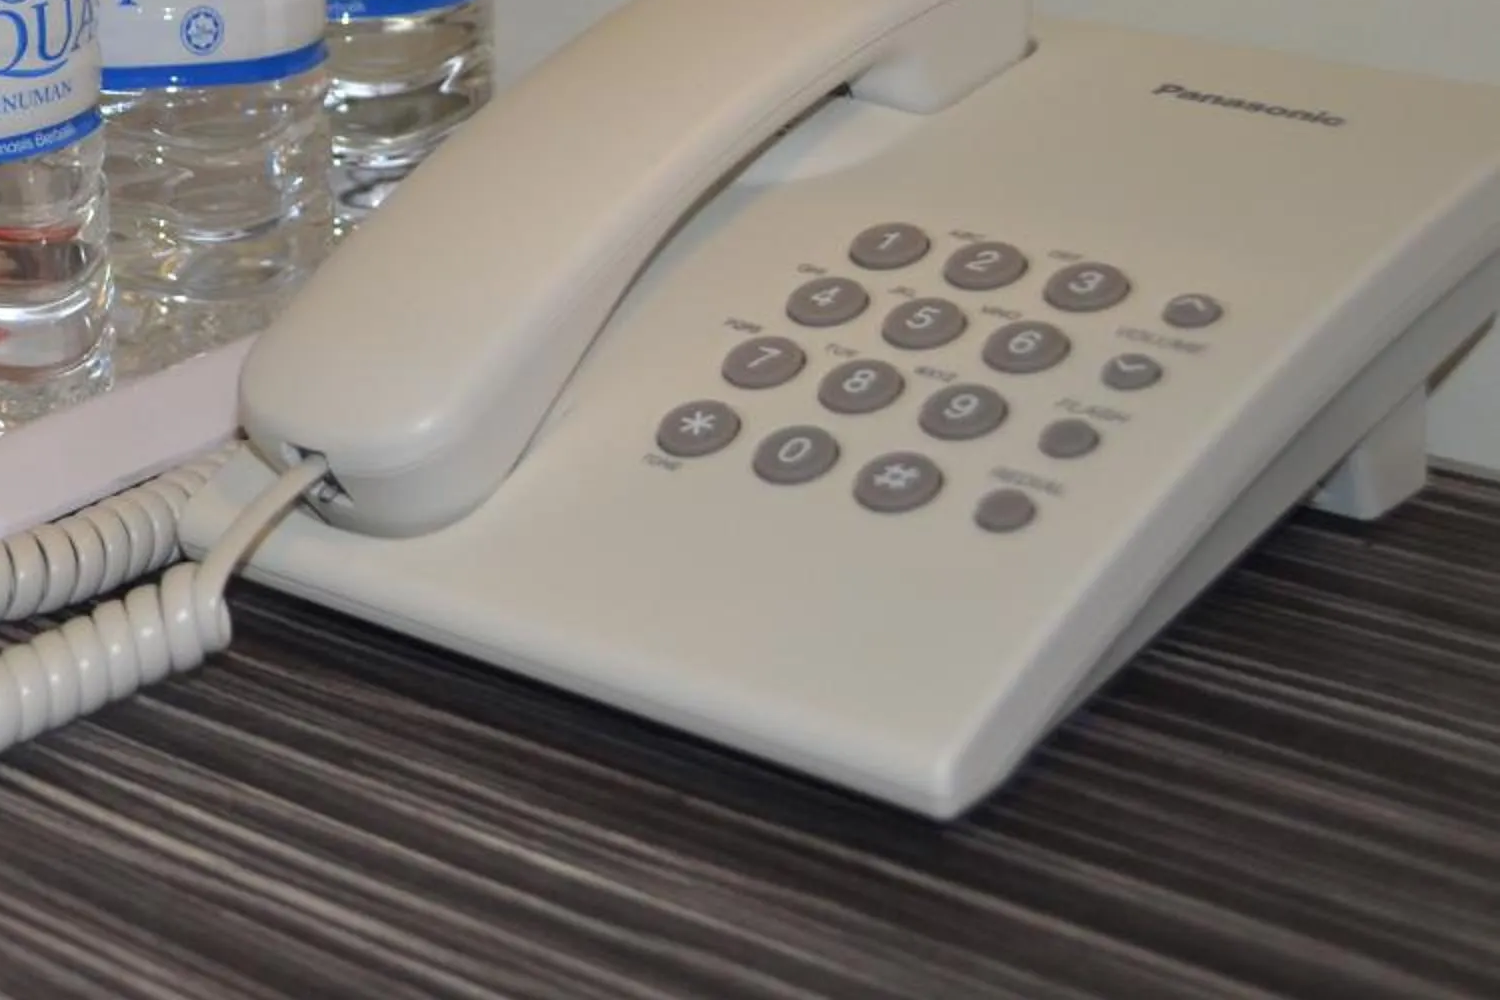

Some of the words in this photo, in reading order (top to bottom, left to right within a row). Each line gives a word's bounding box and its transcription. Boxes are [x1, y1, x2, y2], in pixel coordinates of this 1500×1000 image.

[1151, 83, 1346, 127] Panasonic
[877, 231, 901, 250] 1
[963, 250, 1001, 272] 2
[1067, 269, 1105, 294] 3
[810, 286, 842, 307] 4
[904, 306, 941, 329] 5
[1008, 330, 1042, 354] 6
[747, 346, 783, 368] 7
[841, 368, 877, 393] 8
[942, 393, 980, 419] 9
[777, 437, 812, 463] 0
